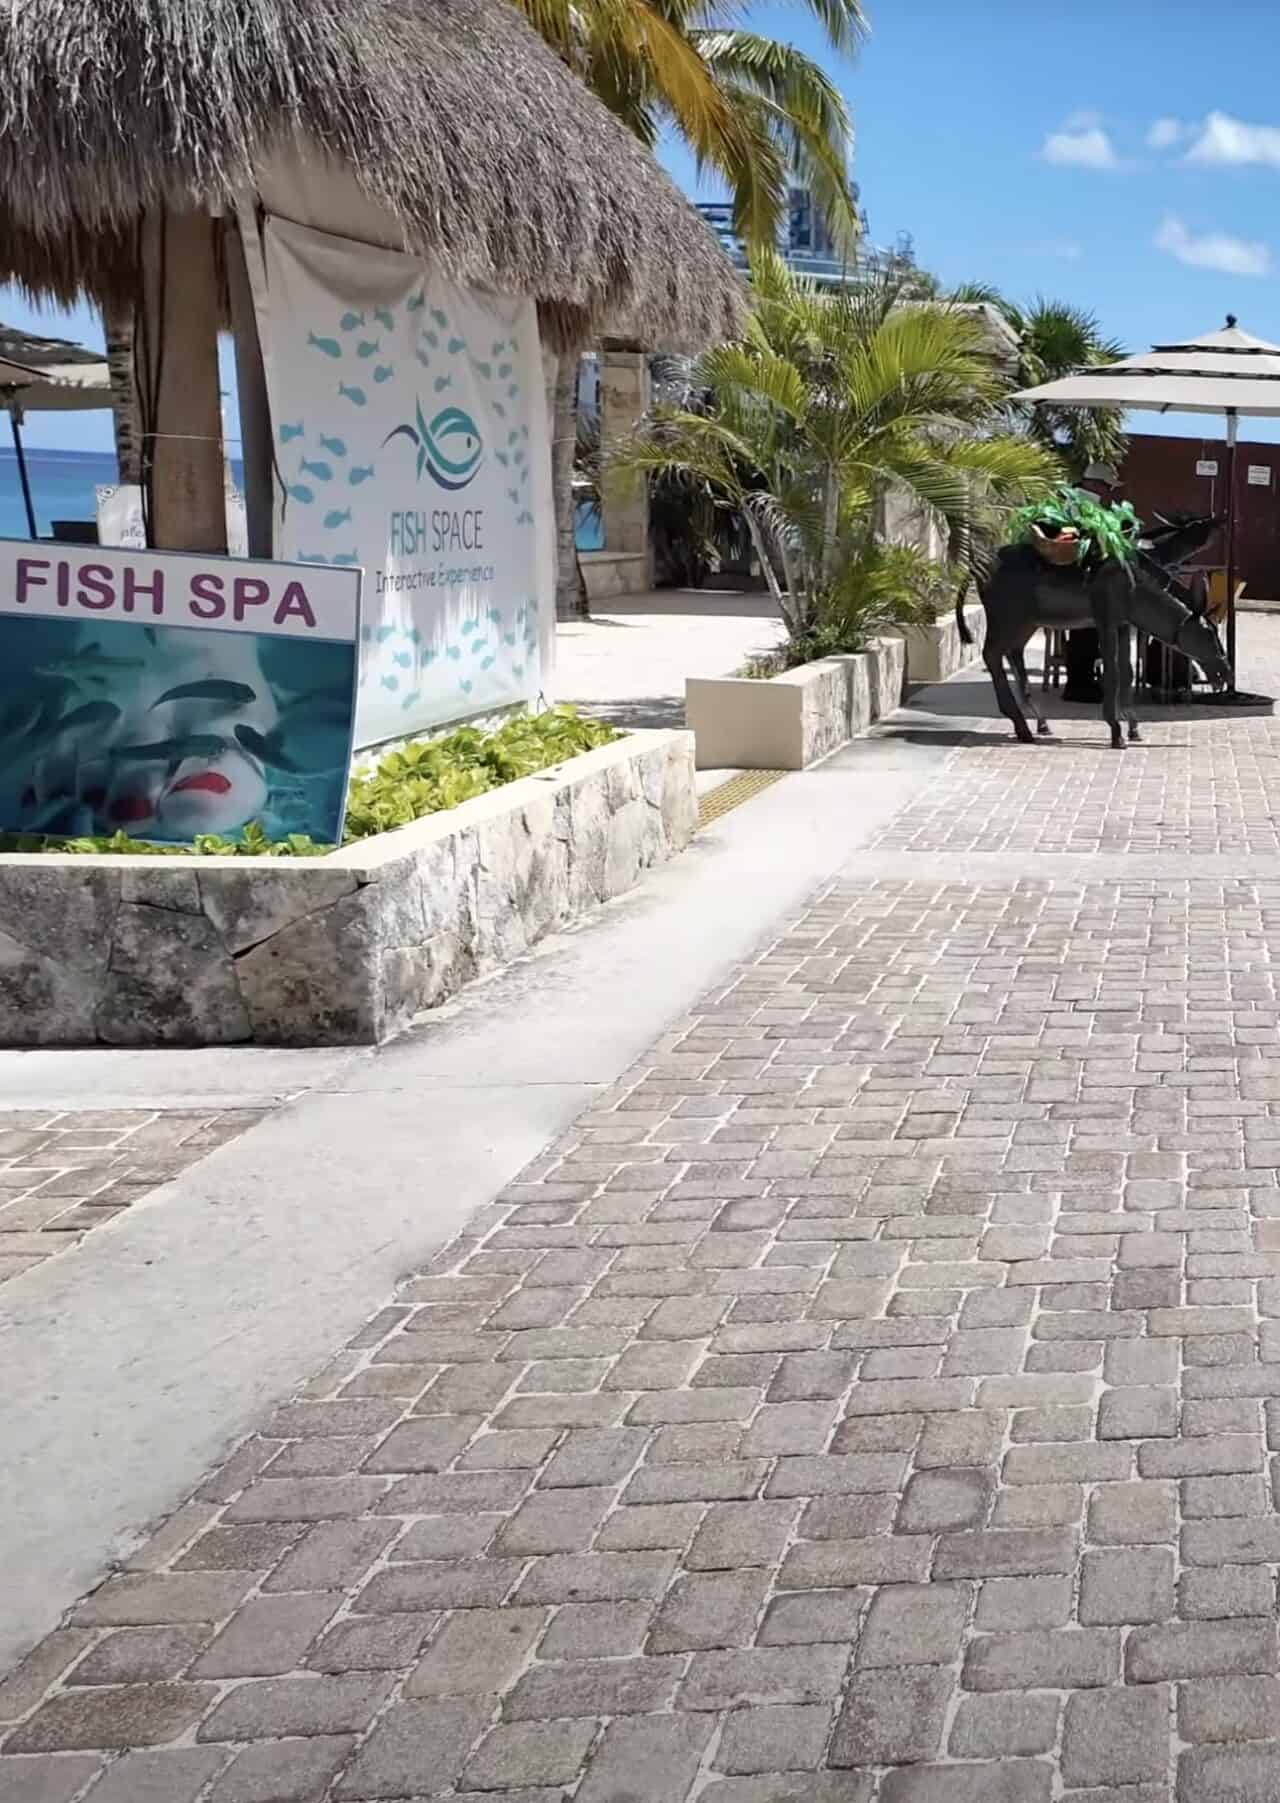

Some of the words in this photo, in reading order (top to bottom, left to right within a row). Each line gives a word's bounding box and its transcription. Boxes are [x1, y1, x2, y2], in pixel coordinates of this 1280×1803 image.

[390, 511, 426, 556] FISH
[432, 509, 483, 552] SPACE
[15, 558, 164, 615] FISH
[188, 573, 317, 628] SPA
[376, 570, 437, 594] Interactive
